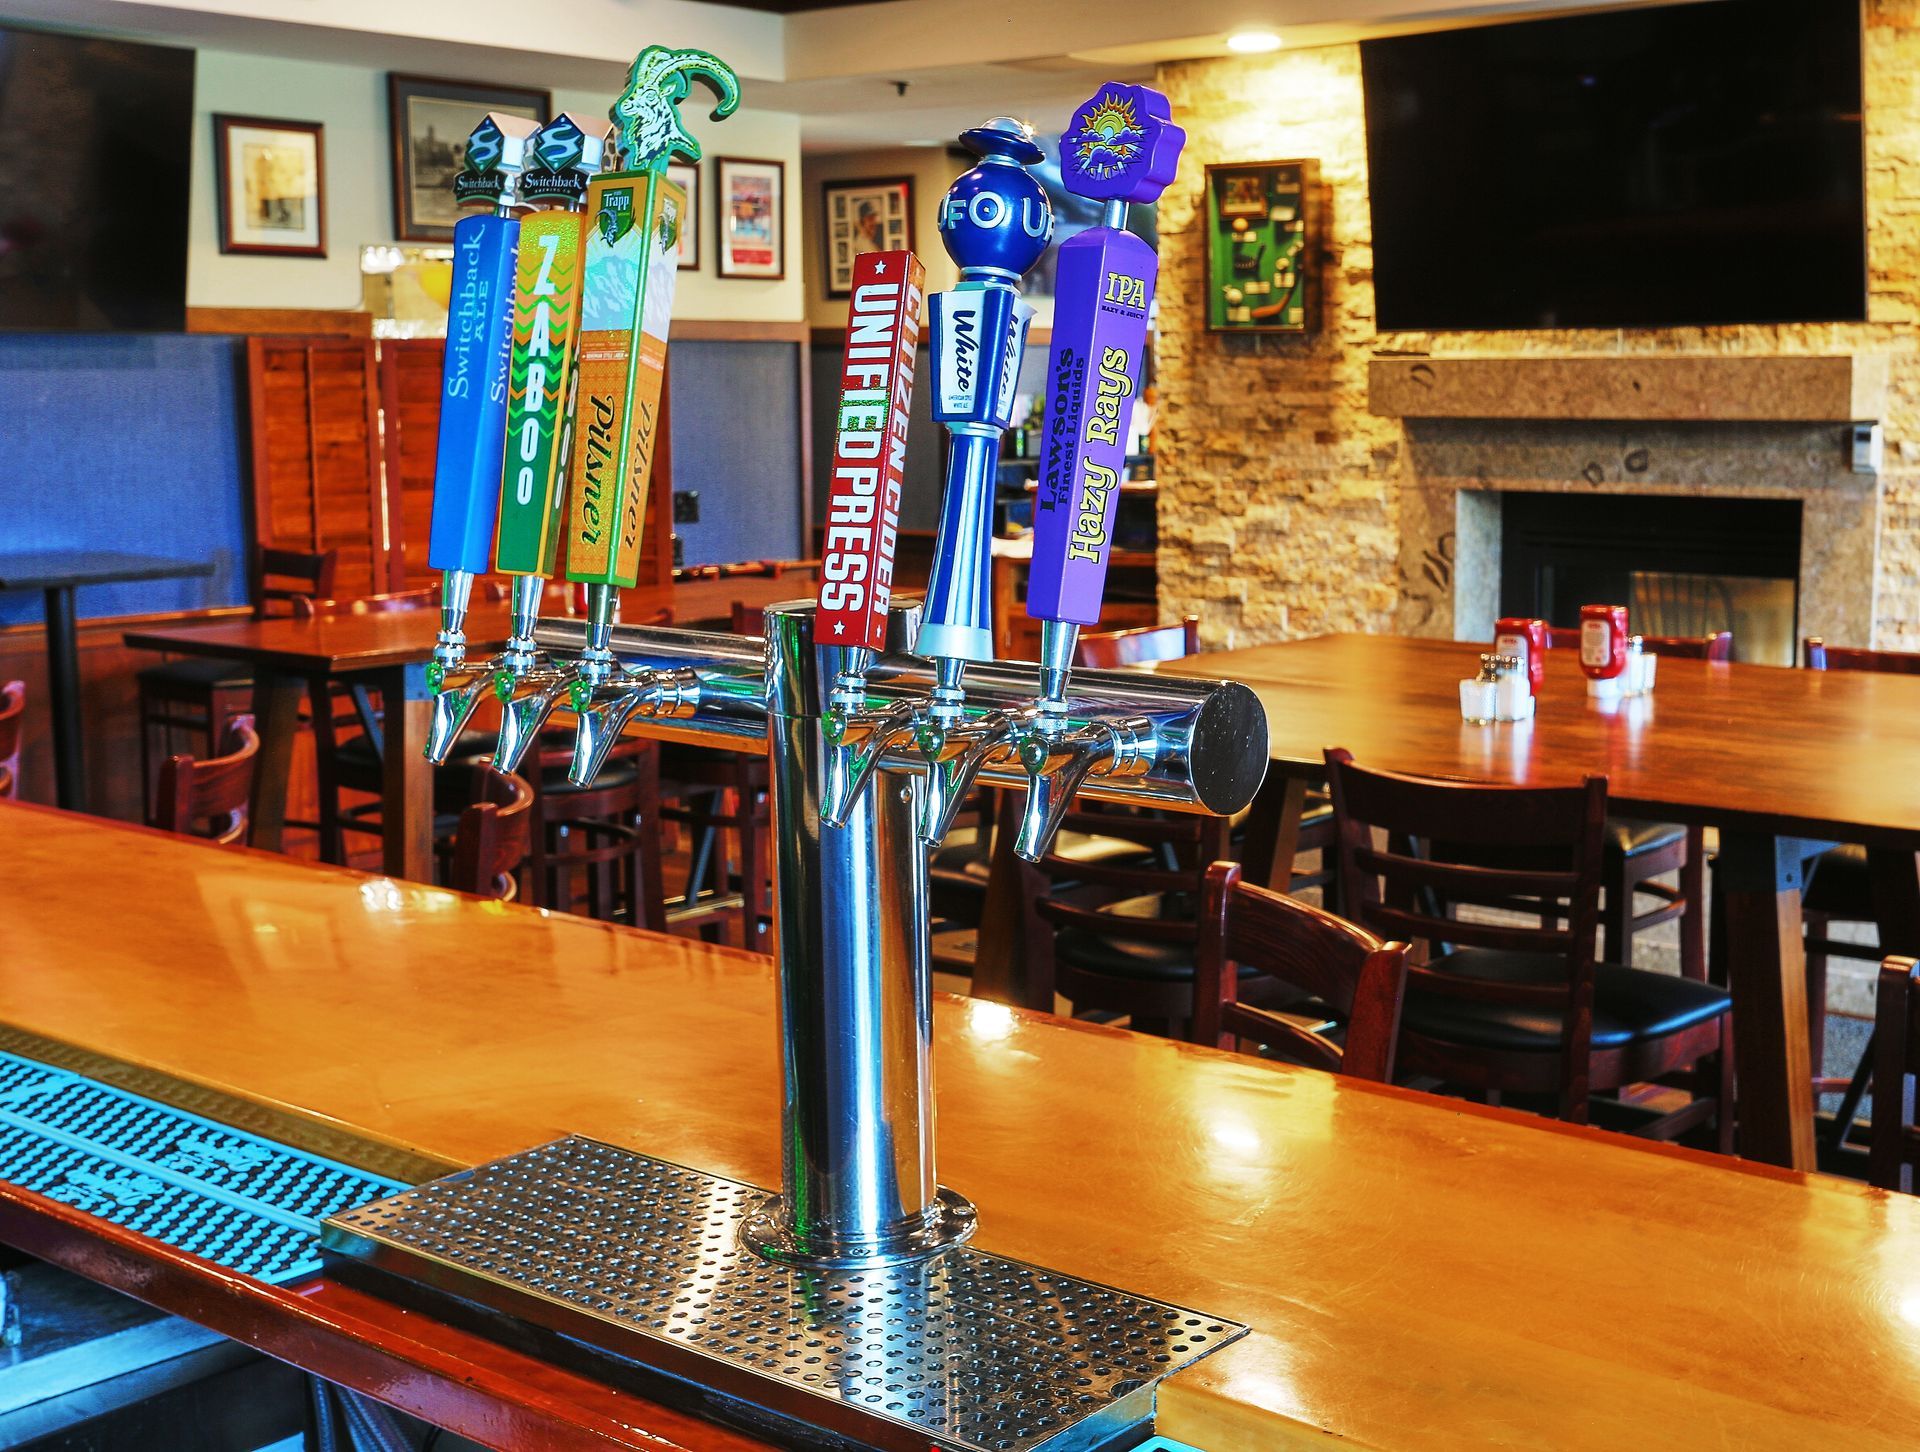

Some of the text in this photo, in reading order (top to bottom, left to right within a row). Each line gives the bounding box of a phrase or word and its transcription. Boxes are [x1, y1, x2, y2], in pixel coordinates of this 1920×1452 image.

[457, 175, 501, 190] Switchback
[524, 173, 582, 190] Switchback
[603, 193, 630, 211] Trapp
[448, 223, 486, 399] Switchback
[475, 280, 489, 342] ALE
[952, 310, 979, 392] White
[1101, 305, 1119, 314] HAZY
[1126, 312, 1145, 320] JUICY
[1104, 272, 1146, 311] IPA
[516, 234, 561, 506] ZABOO
[1040, 348, 1074, 513] Lawson's
[1058, 357, 1085, 504] Finest Liquids
[581, 394, 615, 545] Pilsner
[625, 400, 653, 549] Pilsner
[821, 283, 900, 612] UNIFIED PRESS
[873, 283, 922, 616] CITIZEN CIDER
[1068, 346, 1134, 564] Hazy Rays
